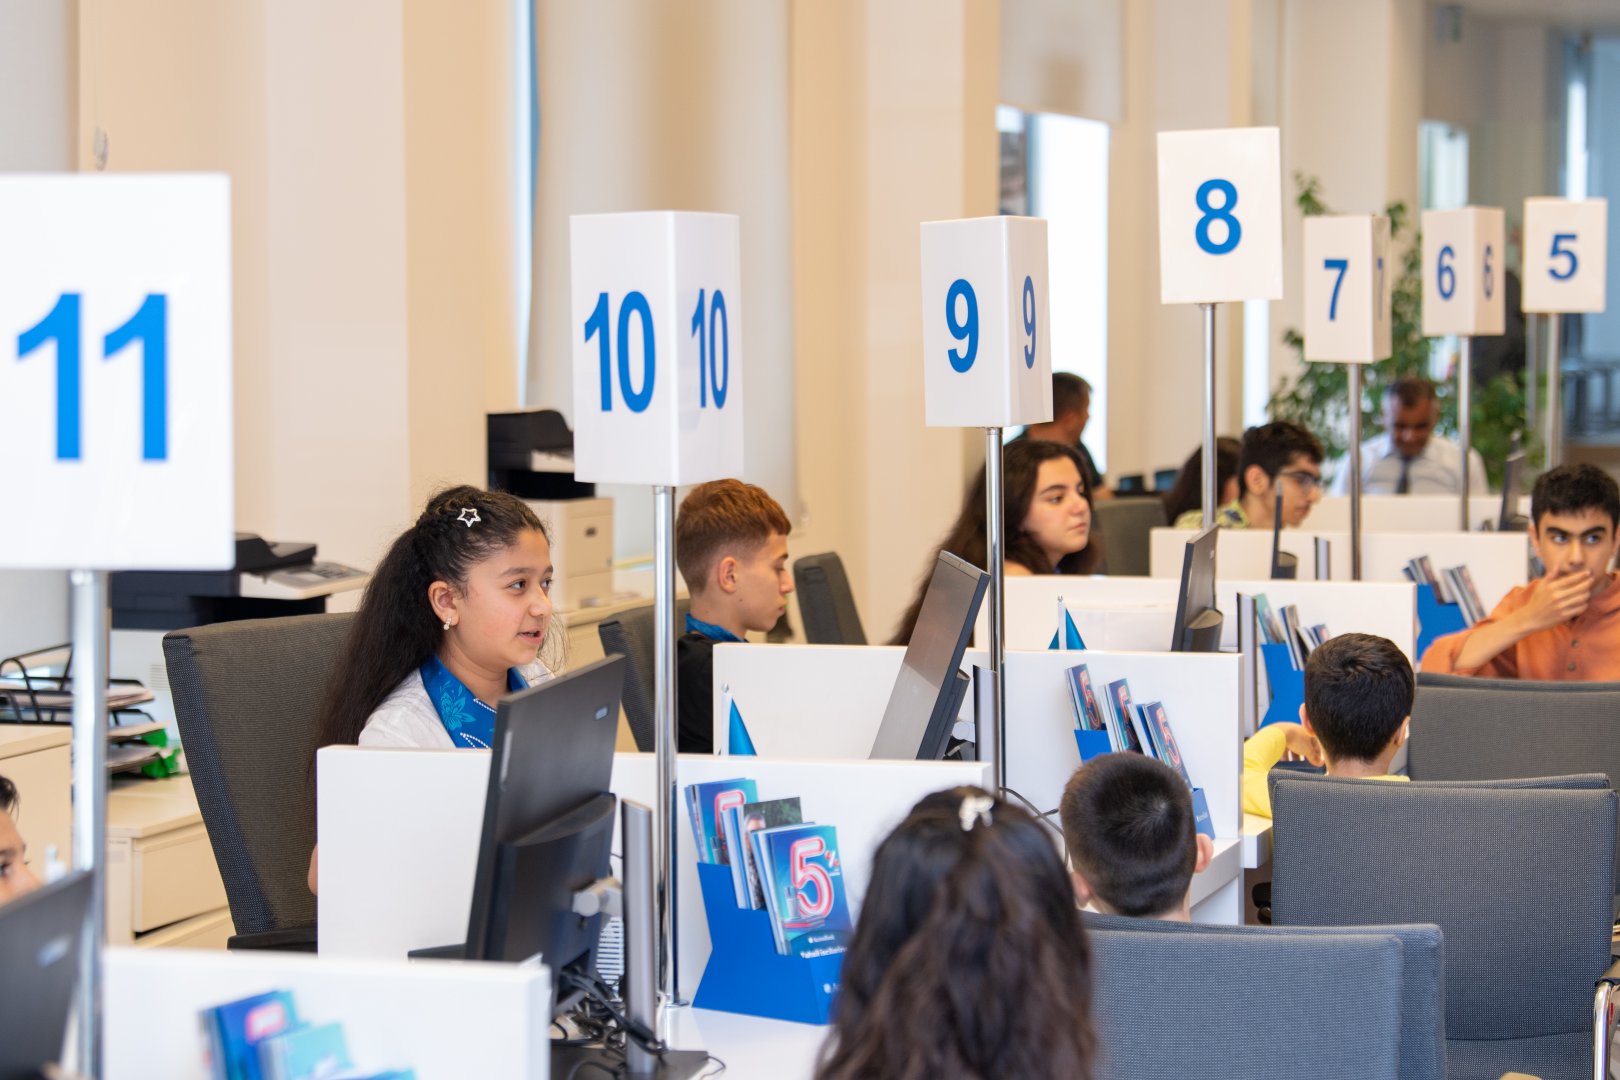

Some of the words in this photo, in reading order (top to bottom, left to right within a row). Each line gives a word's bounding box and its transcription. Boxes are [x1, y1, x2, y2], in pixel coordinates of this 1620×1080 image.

[1195, 179, 1242, 254] 8
[1548, 233, 1578, 280] 5
[1324, 259, 1349, 321] 7
[1437, 245, 1456, 301] 6
[1483, 244, 1495, 301] 6
[584, 290, 656, 413] 10
[691, 288, 730, 410] 10
[945, 278, 979, 373] 9
[1022, 275, 1037, 369] 9
[17, 292, 168, 462] 11
